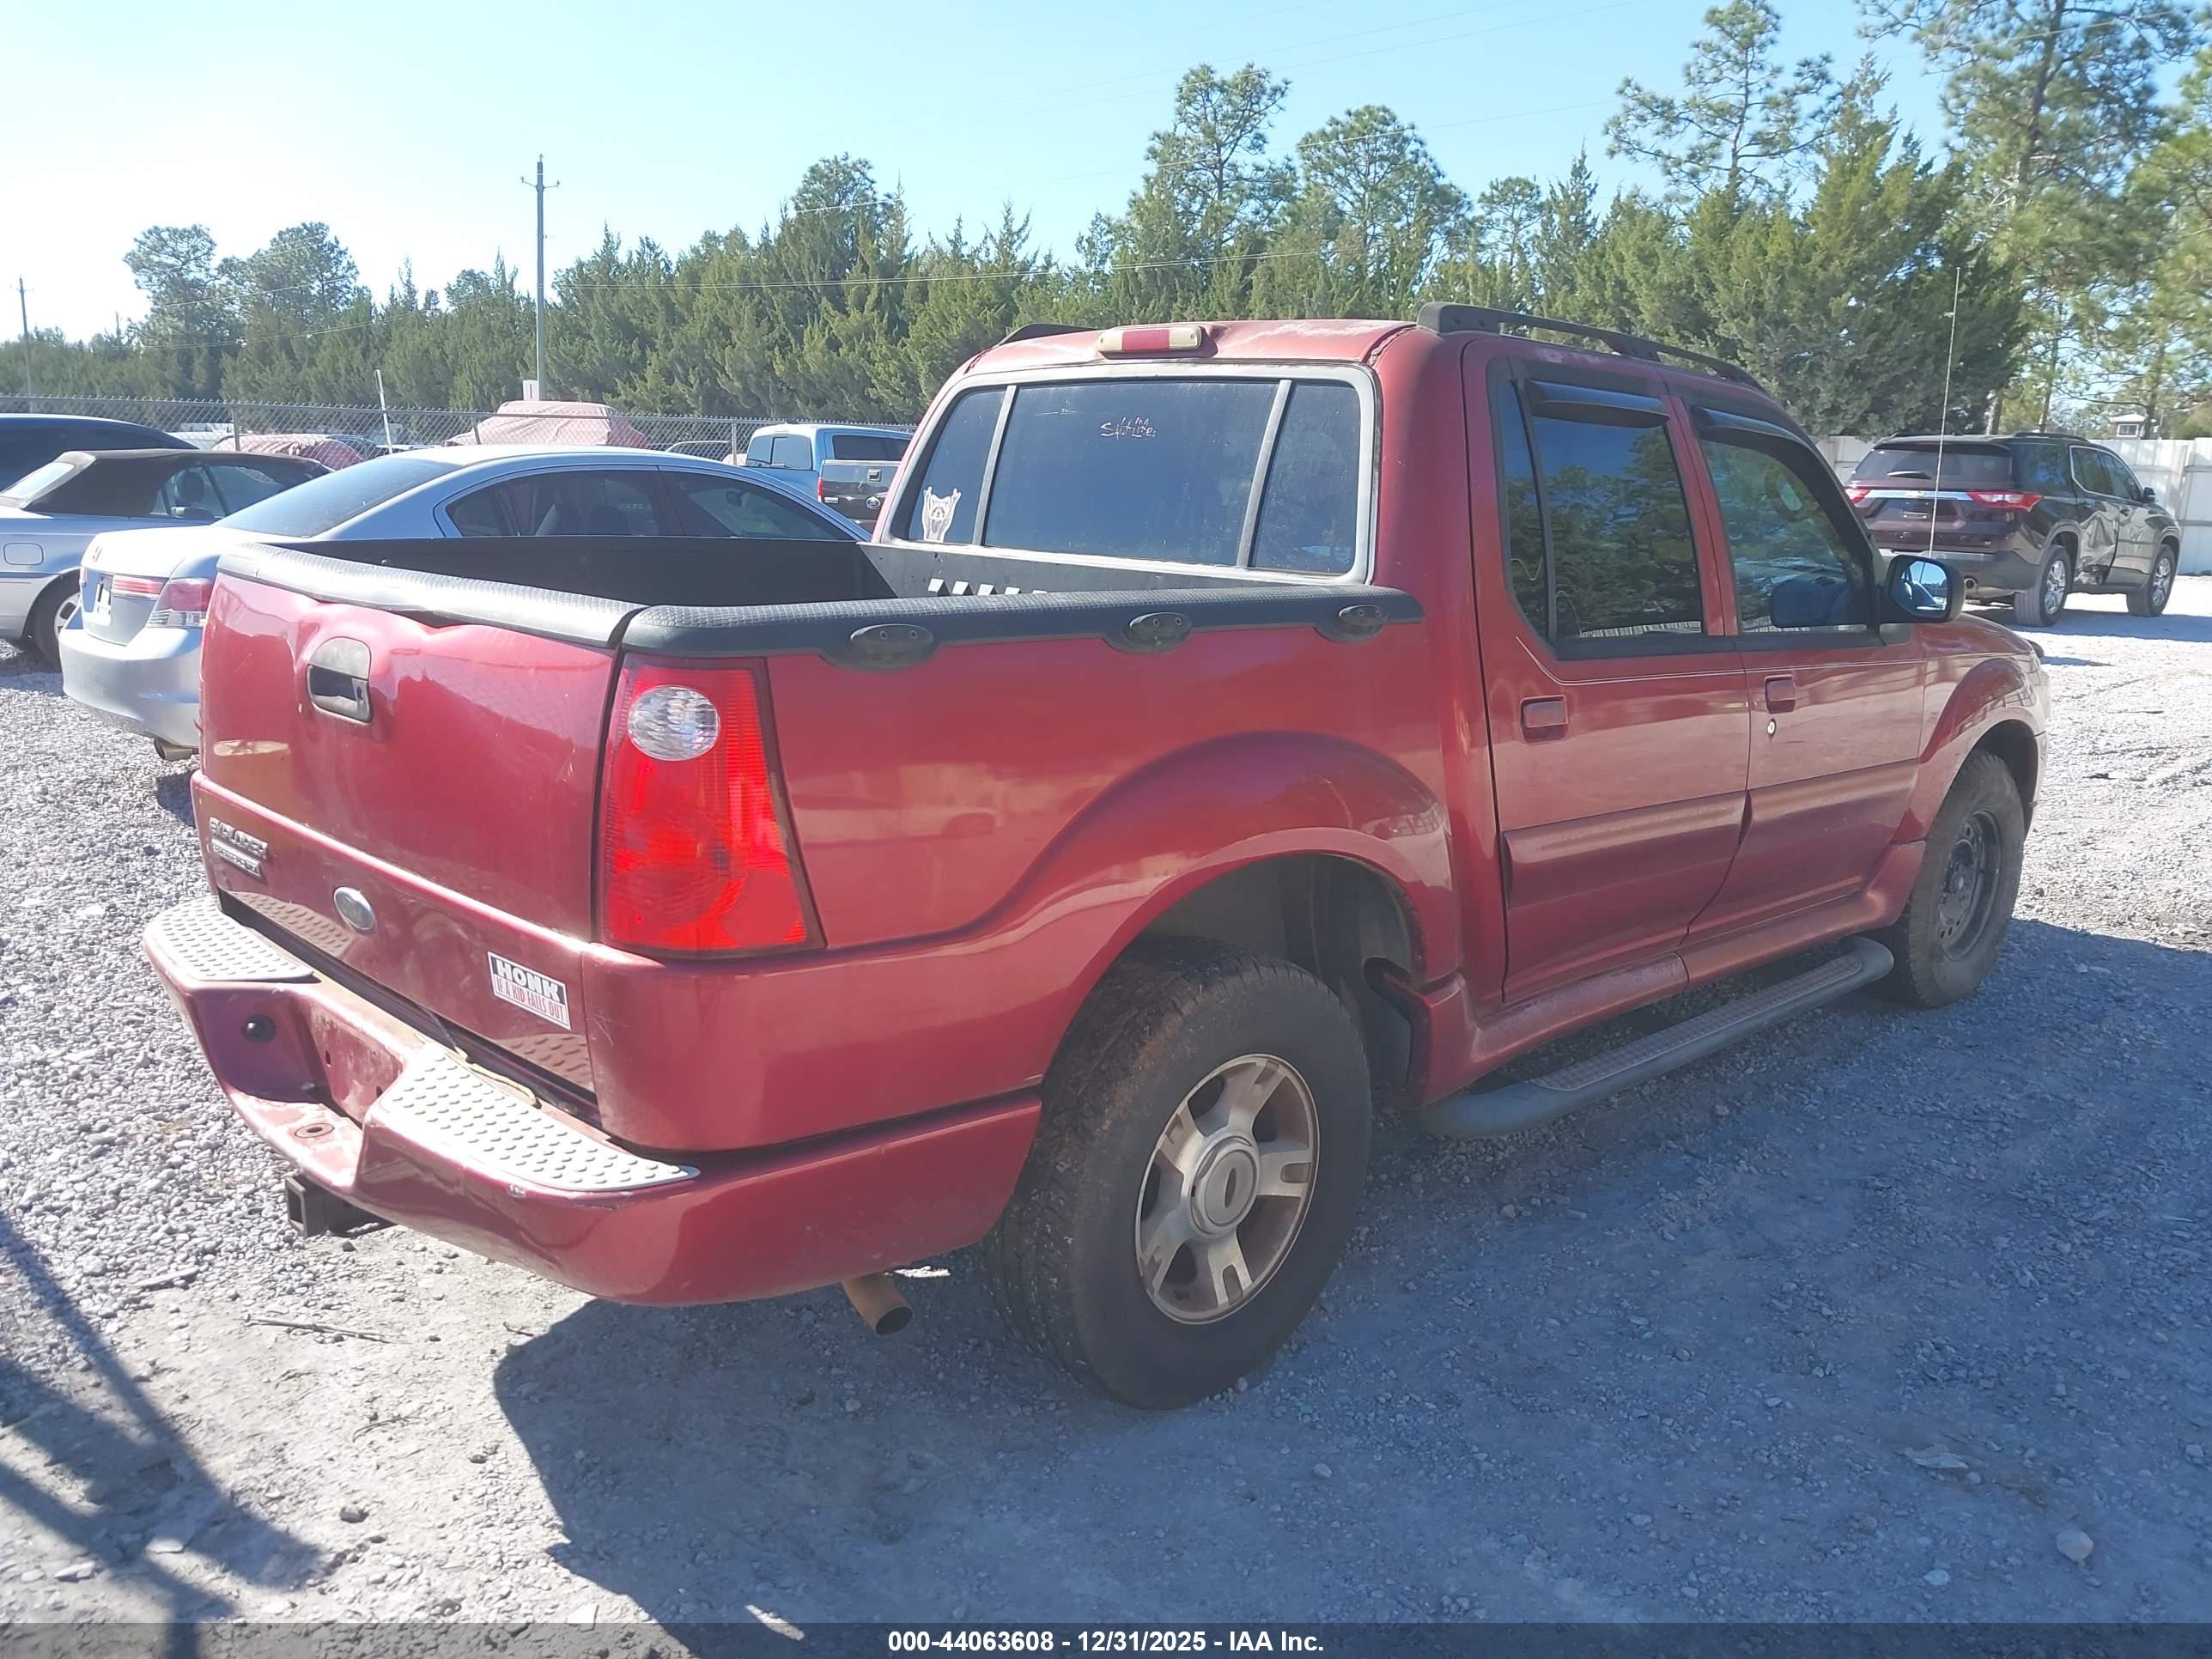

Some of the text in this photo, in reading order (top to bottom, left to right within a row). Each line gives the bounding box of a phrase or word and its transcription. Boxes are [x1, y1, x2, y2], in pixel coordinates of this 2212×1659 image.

[495, 959, 560, 1002] HONK
[495, 976, 564, 1021] IF A KID FALLS OUT
